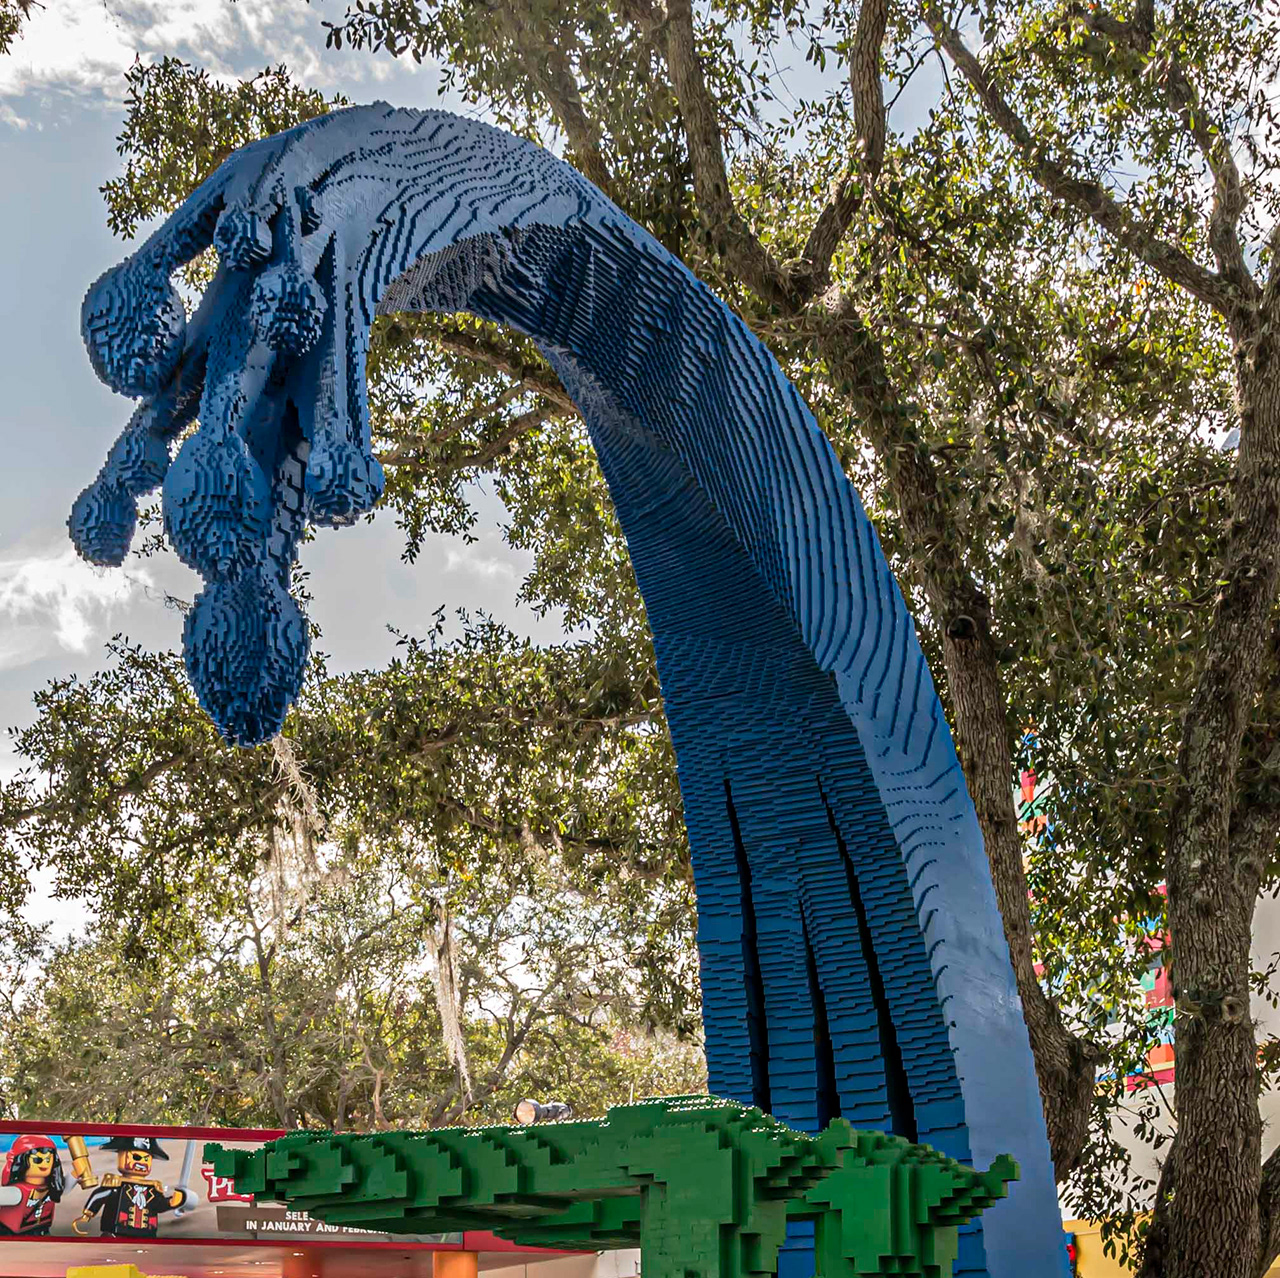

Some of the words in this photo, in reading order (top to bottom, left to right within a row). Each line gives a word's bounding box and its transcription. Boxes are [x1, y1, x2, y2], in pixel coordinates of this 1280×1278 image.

[285, 1211, 316, 1221] SELE
[246, 1220, 257, 1230] IN
[261, 1220, 311, 1232] JANUARY
[316, 1222, 339, 1233] AND
